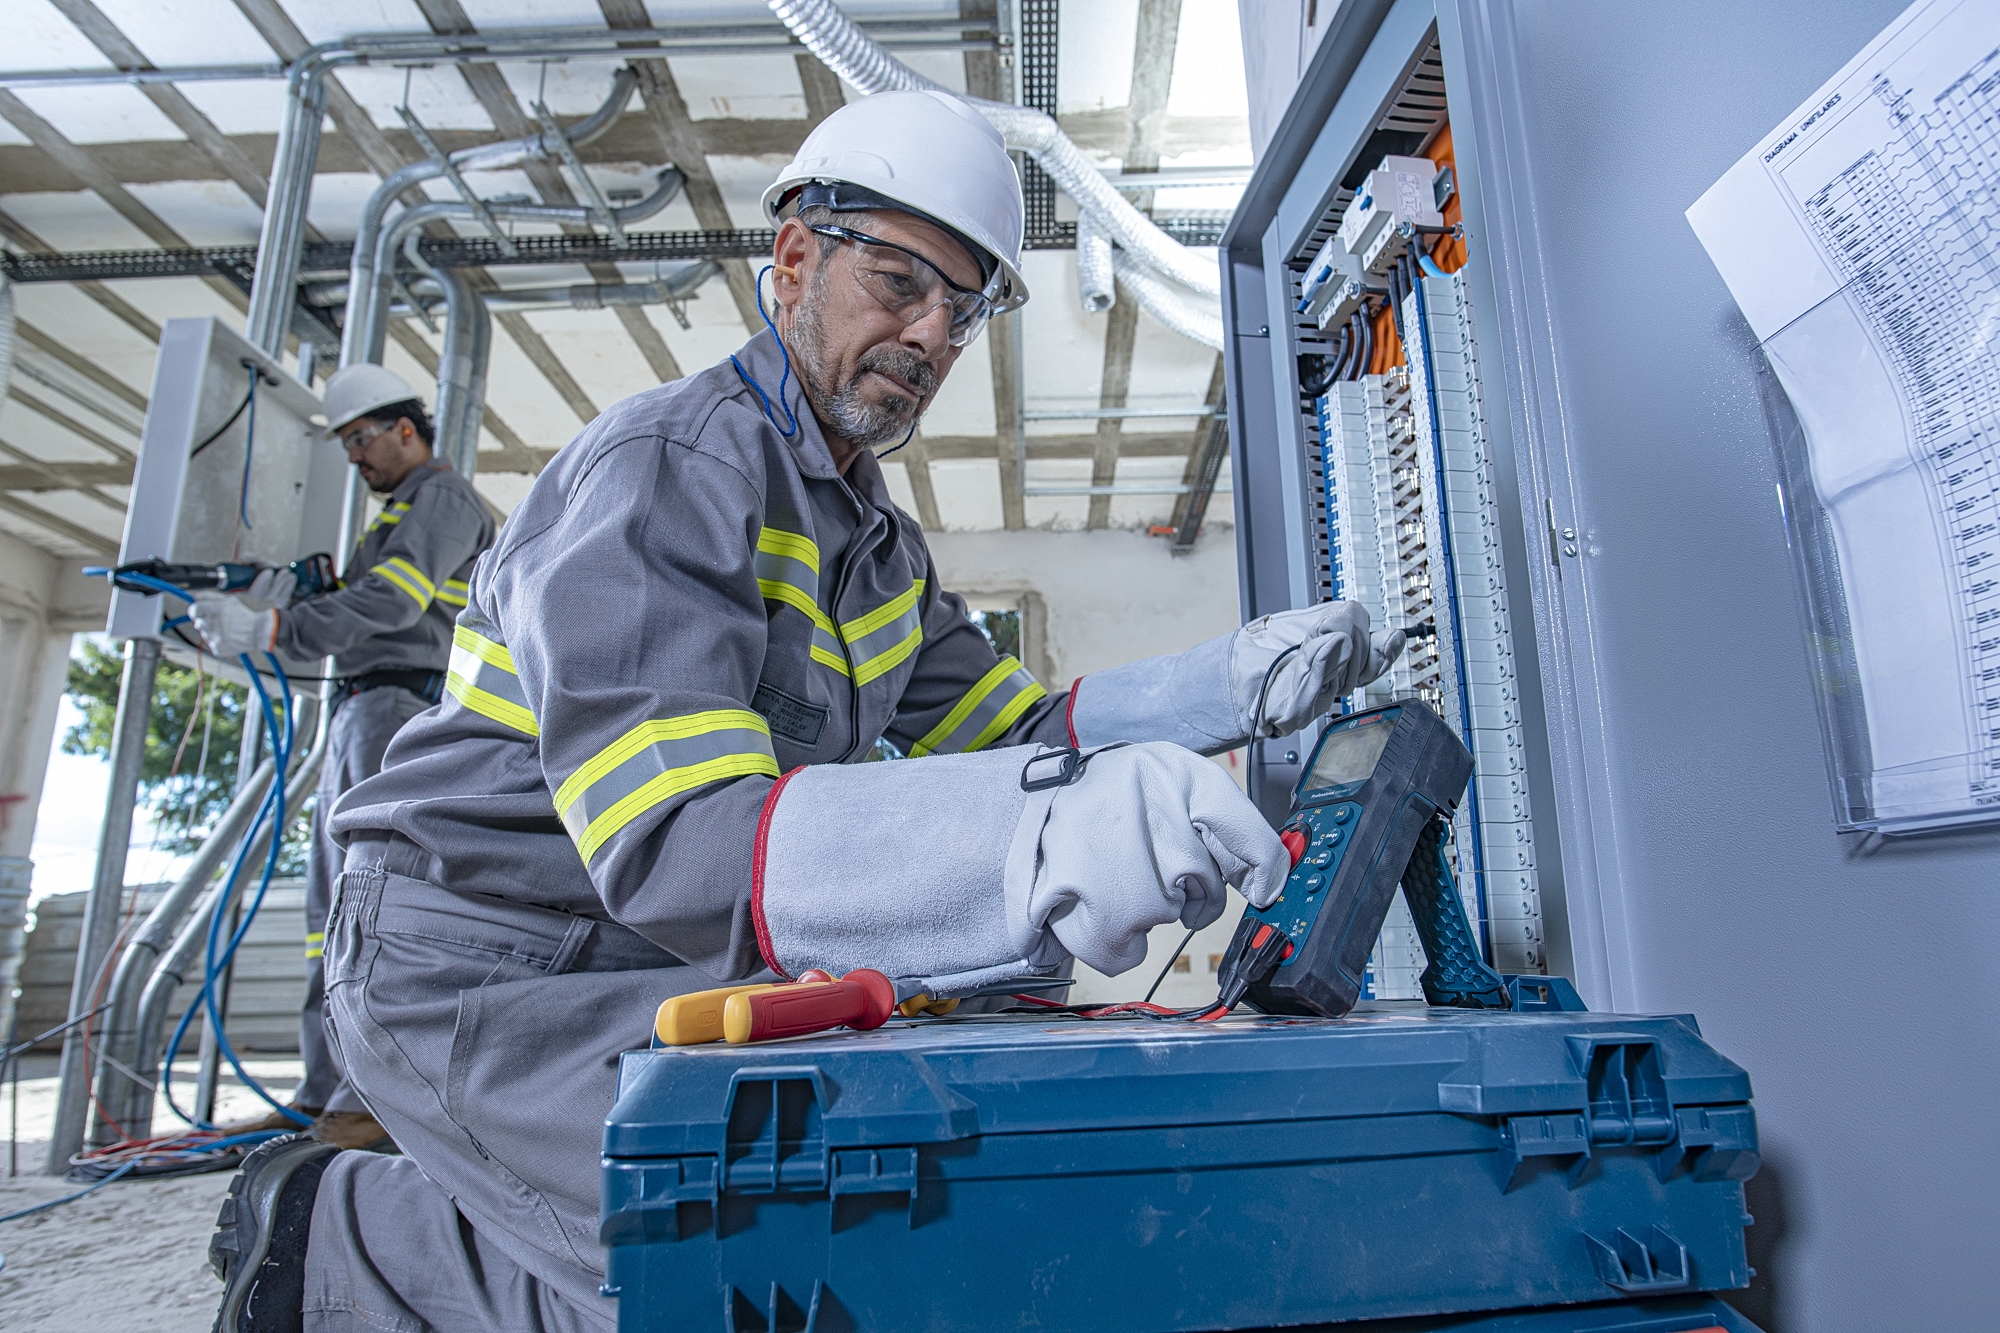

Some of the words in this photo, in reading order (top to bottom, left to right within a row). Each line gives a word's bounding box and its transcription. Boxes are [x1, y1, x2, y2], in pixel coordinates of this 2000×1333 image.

[1764, 132, 1798, 163] DIAGRAMA
[1800, 93, 1842, 132] UNIFILARES
[756, 690, 780, 704] AMISA
[782, 701, 793, 709] DE
[780, 708, 799, 720] RISCO
[1358, 714, 1383, 726] BOSCH
